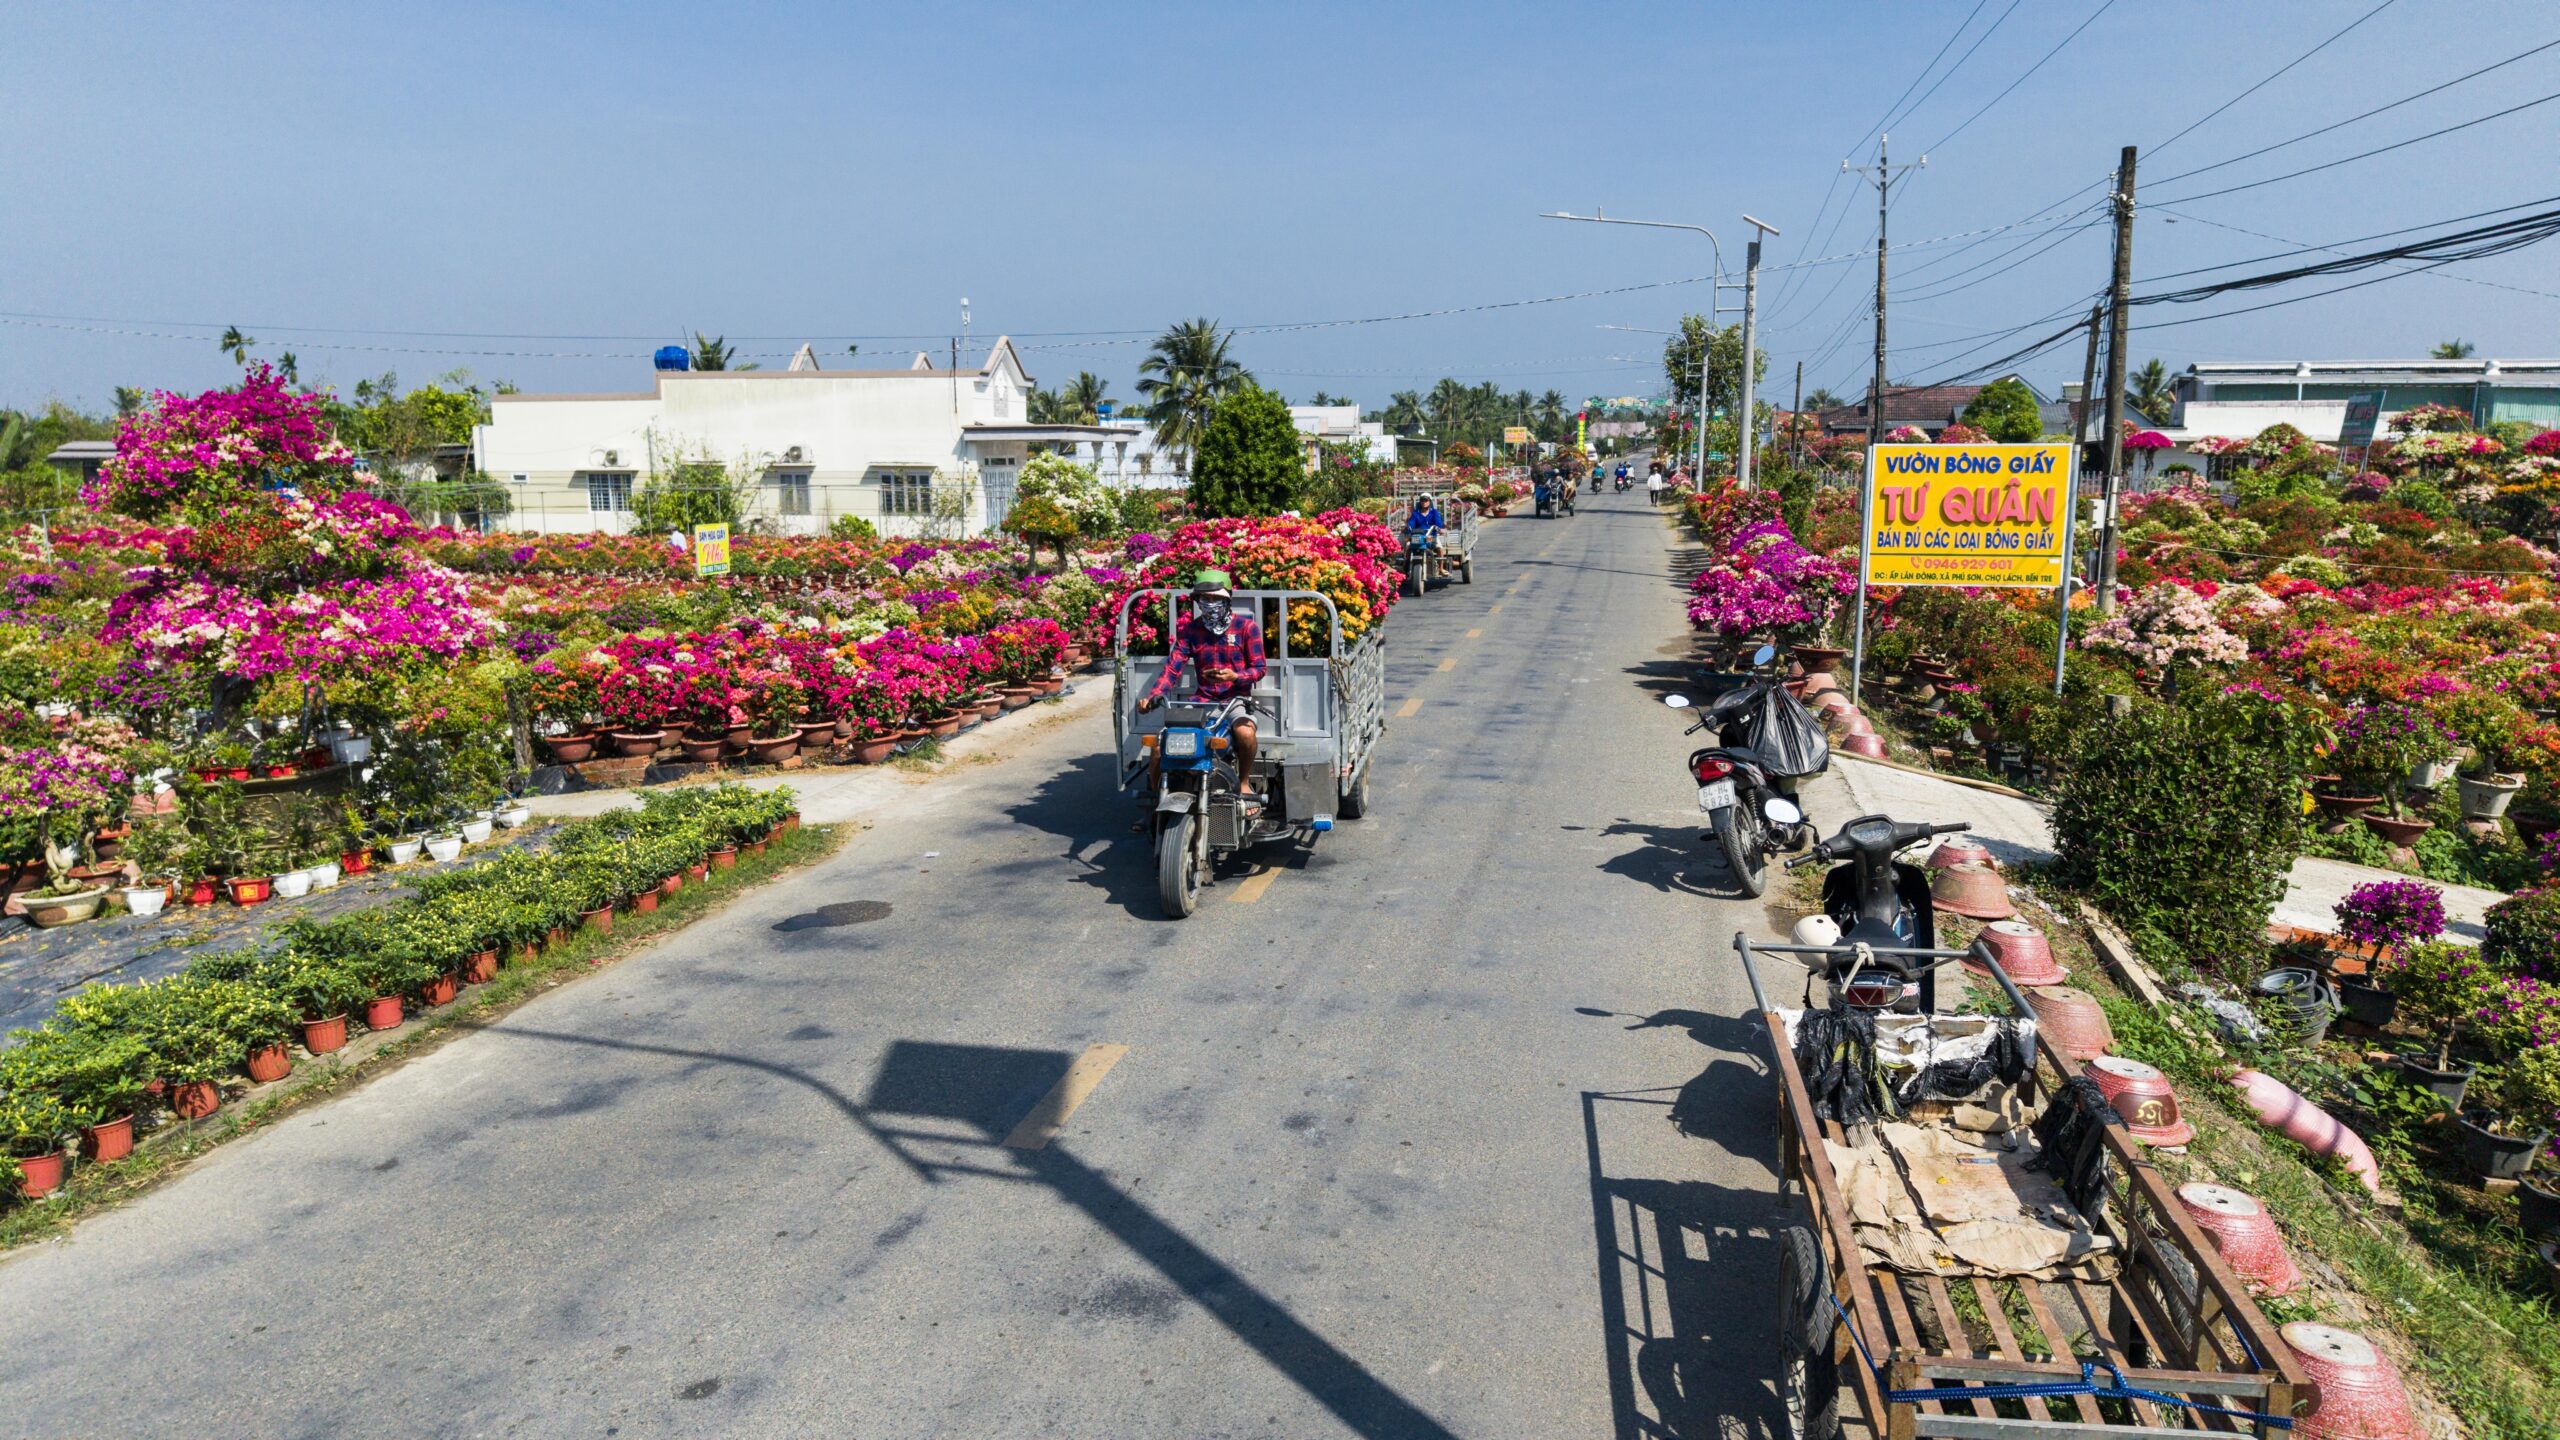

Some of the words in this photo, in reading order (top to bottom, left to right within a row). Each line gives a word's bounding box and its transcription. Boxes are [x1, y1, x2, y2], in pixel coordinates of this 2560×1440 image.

[1886, 452, 1939, 473] VƯỜN
[1944, 452, 2001, 473] BÔNG
[2009, 450, 2056, 473] GIẤY
[1880, 481, 1931, 524] TƯ
[1940, 478, 2056, 527] QUÂN
[1877, 528, 1900, 548] BÁN
[1904, 526, 1921, 548] ĐỦ
[1924, 528, 1950, 549] CÁC
[1954, 533, 1981, 552] LOẠI
[1985, 528, 2020, 549] BÔNG
[2024, 527, 2055, 550] GIẤY
[1924, 559, 1959, 570] 0946
[1961, 560, 1987, 570] 929
[1989, 560, 2013, 570] 601
[1985, 573, 2001, 583] CHỢ
[2040, 574, 2053, 582] TRE
